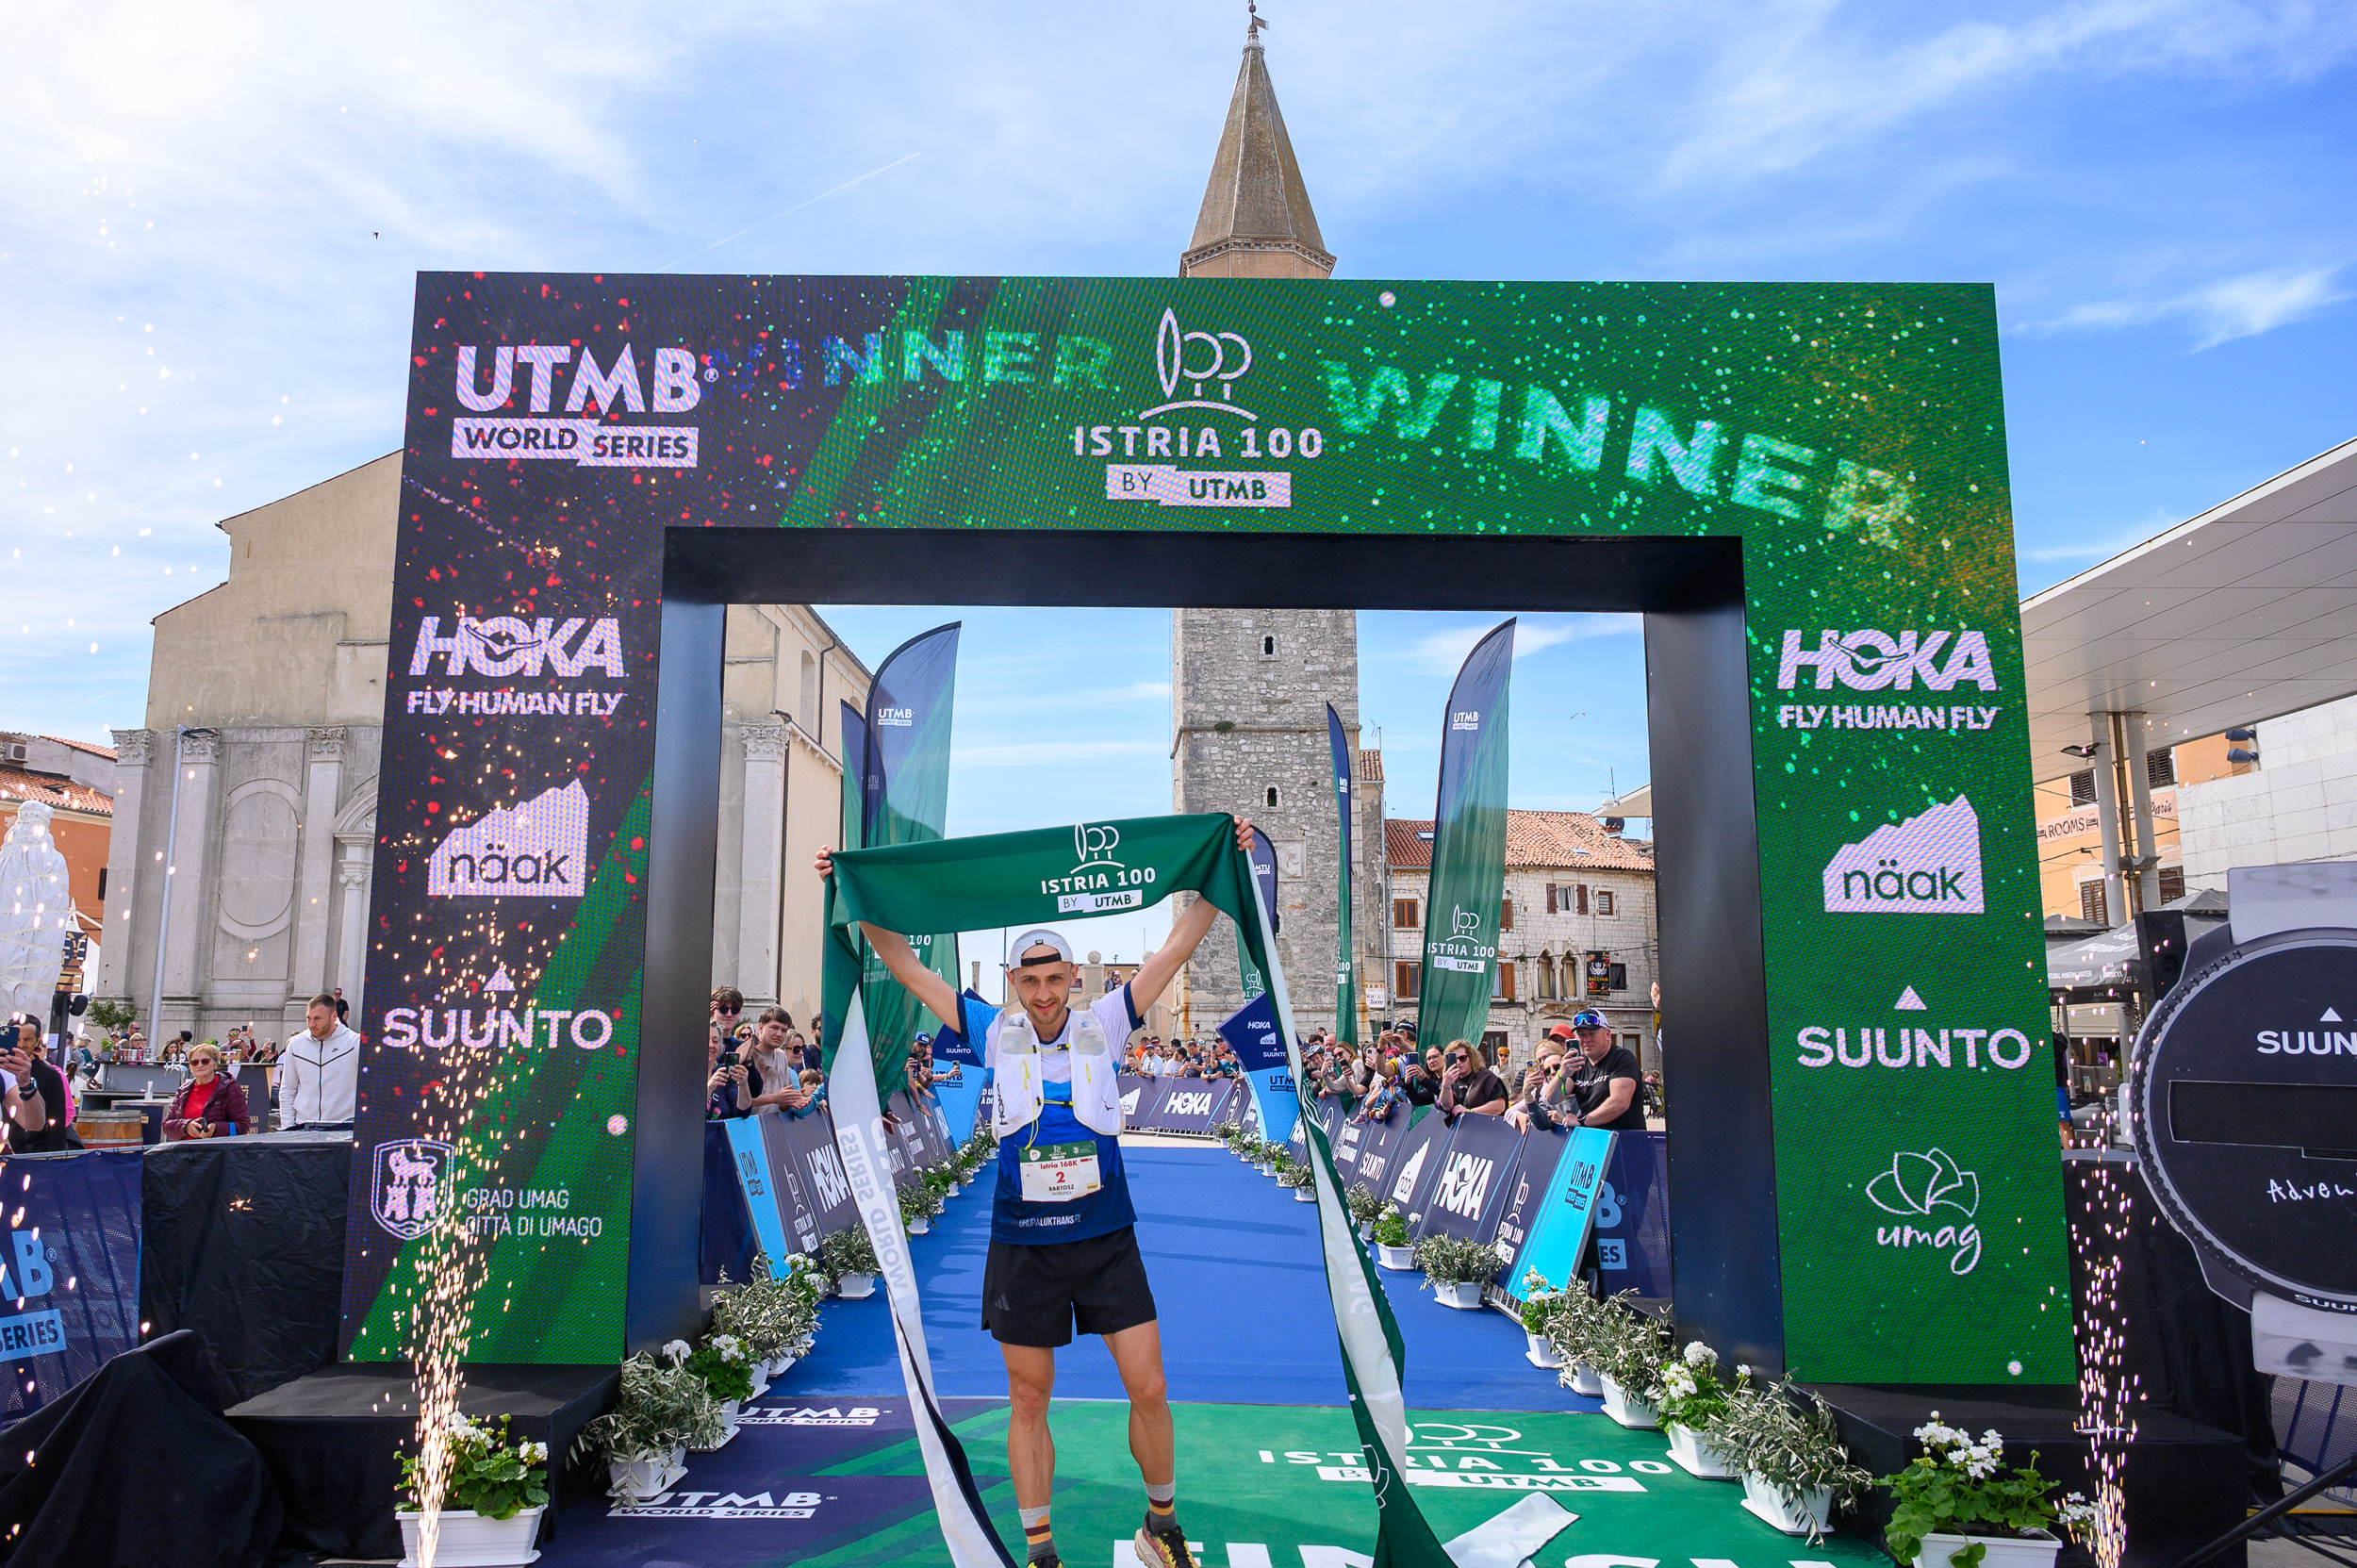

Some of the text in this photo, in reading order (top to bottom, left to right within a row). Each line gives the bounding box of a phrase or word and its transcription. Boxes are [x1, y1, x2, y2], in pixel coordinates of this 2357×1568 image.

[465, 427, 689, 458] WORLD SERIES
[1074, 425, 1324, 459] ISTRIA 100
[1320, 360, 1910, 550] WINNER
[1123, 471, 1267, 501] BY UTMB
[409, 616, 626, 678] HOKA
[1777, 629, 1999, 691] HOKA
[407, 691, 624, 716] FLY HUMAN FLY
[878, 707, 913, 718] UTMB
[1454, 711, 1478, 723] UTMB
[1779, 705, 1997, 730] FLY HUMAN FLY
[2048, 817, 2085, 837] ROOMS
[450, 842, 569, 884] näak
[1041, 867, 1156, 894] ISTRIA 100
[1844, 860, 1964, 900] näak
[1063, 894, 1132, 909] BY UTMB
[1427, 942, 1495, 958] ISTRIA 100
[1457, 961, 1479, 970] UTMB
[383, 1008, 614, 1049] SUUNTO
[1797, 1027, 2031, 1070] SUUNTO
[1164, 1092, 1211, 1115] HOKA
[1040, 1160, 1078, 1170] Istria 168K
[1056, 1171, 1065, 1183] 2
[1571, 1160, 1595, 1190] UTMB
[806, 1144, 851, 1213] HOKA
[1433, 1150, 1493, 1222] HOKA
[467, 1188, 569, 1209] GRAD UMAG
[465, 1212, 602, 1236] CITTÀ DI UMAGO
[1877, 1223, 1982, 1275] umag
[1530, 1458, 1673, 1475] 100
[1459, 1475, 1603, 1490] UTMB
